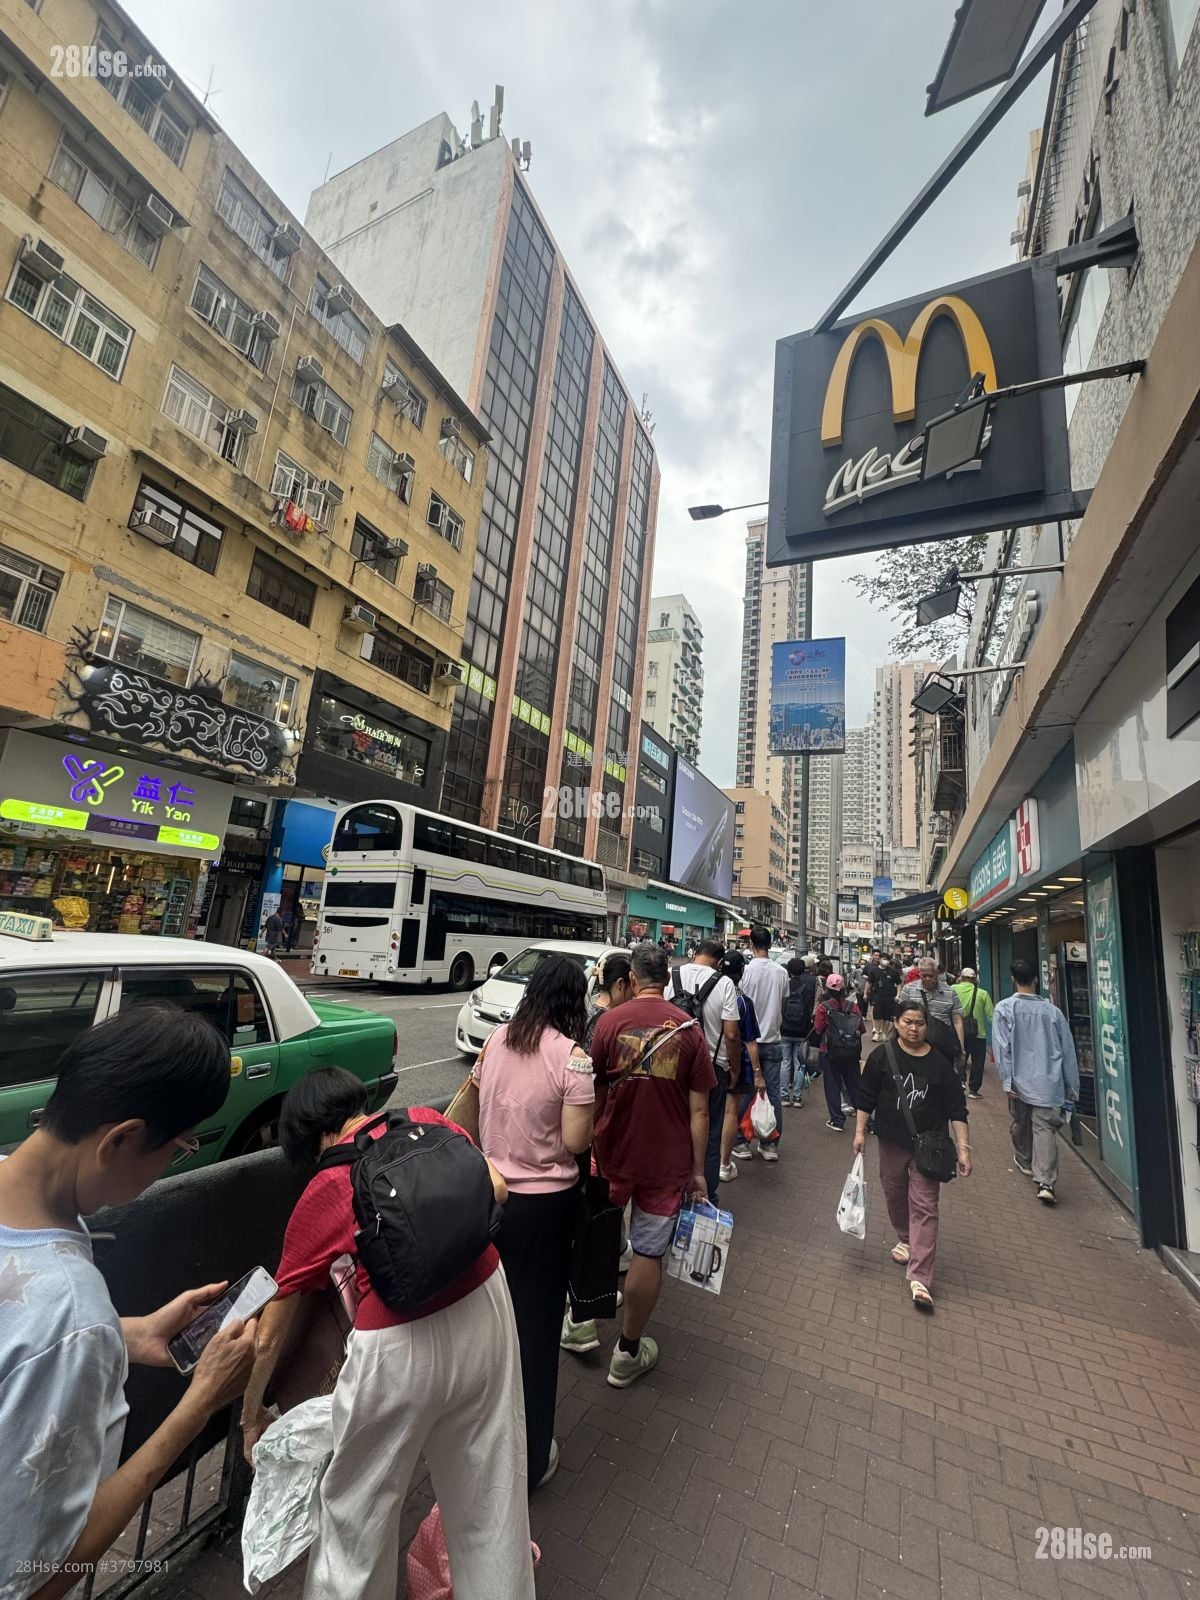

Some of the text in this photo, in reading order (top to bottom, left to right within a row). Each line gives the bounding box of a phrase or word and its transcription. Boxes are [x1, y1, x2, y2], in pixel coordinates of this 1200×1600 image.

[131, 774, 196, 806] 益仁
[131, 799, 191, 823] Yik Yan
